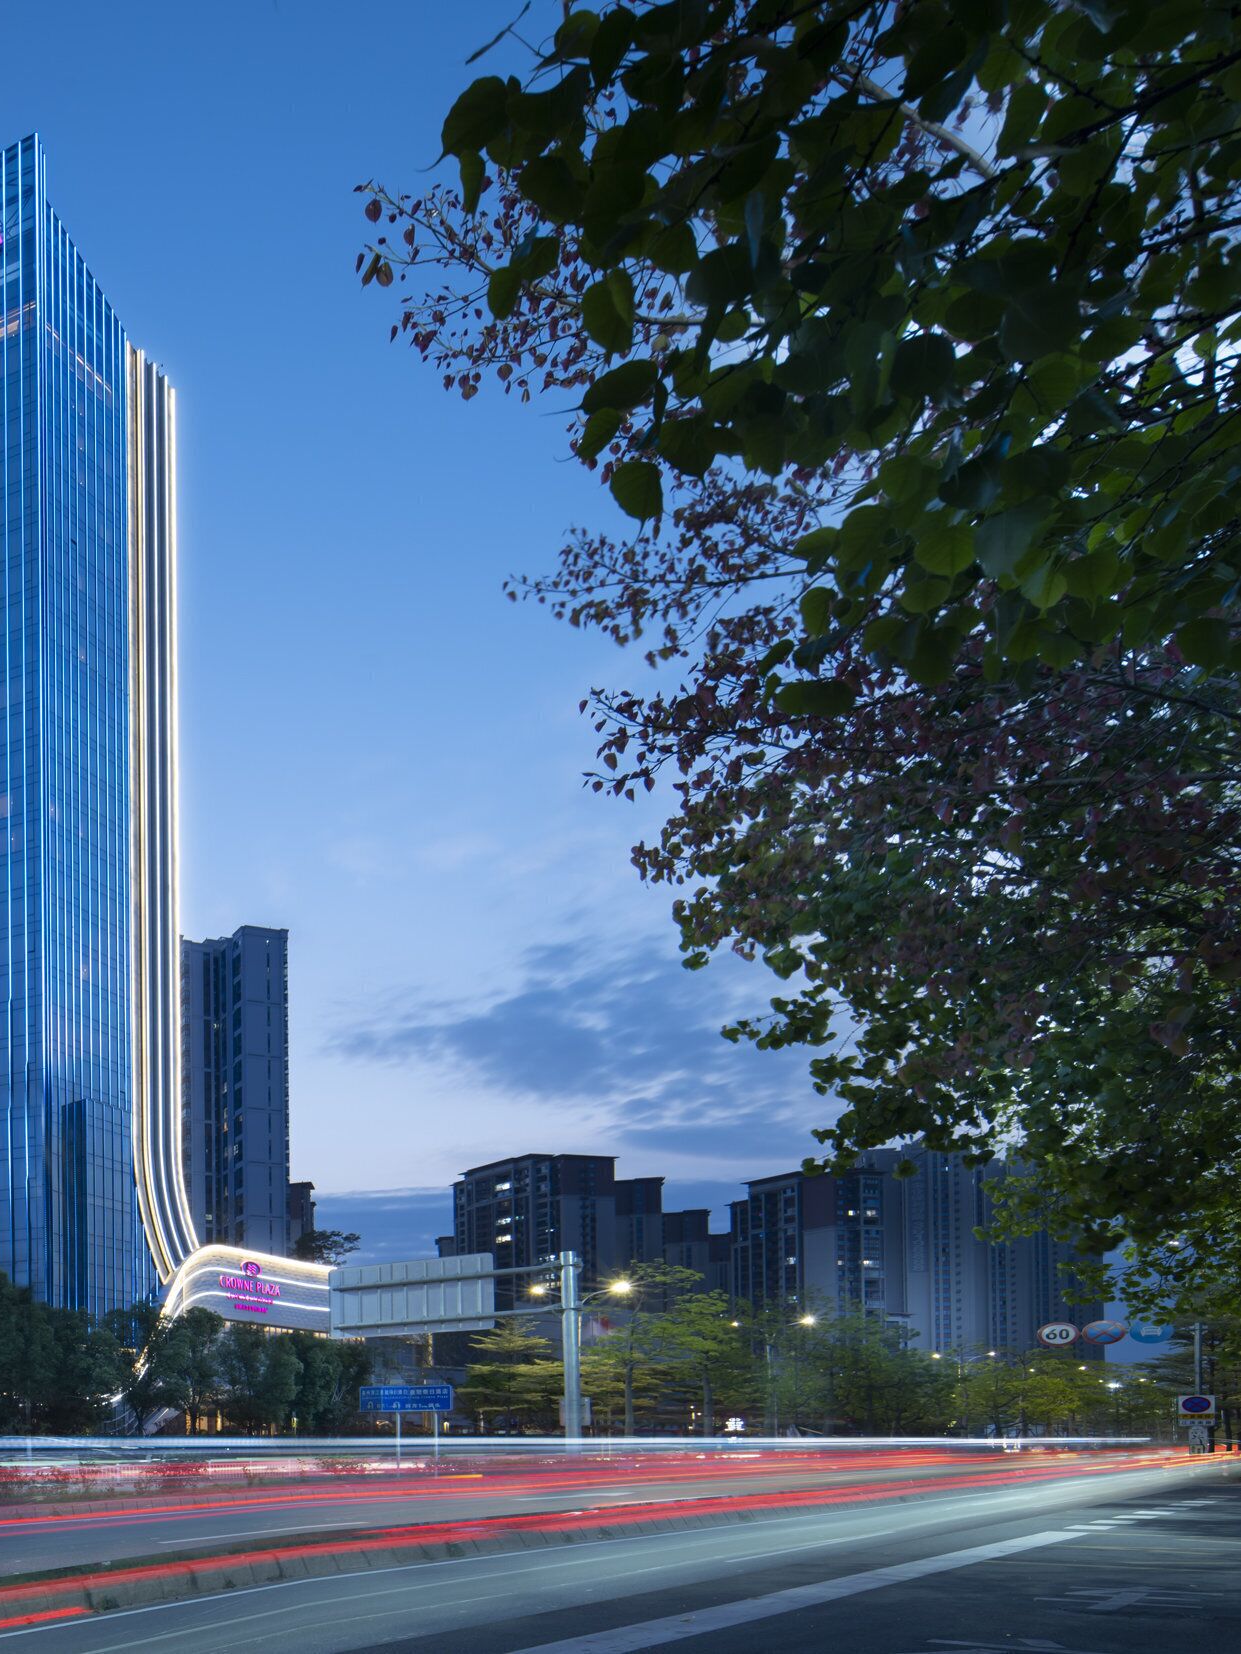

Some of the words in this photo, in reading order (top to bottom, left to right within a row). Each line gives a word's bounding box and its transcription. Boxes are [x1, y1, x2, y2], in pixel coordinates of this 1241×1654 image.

[219, 1275, 254, 1293] CROWNE
[255, 1281, 281, 1296] PLAZA
[1046, 1329, 1069, 1340] 60
